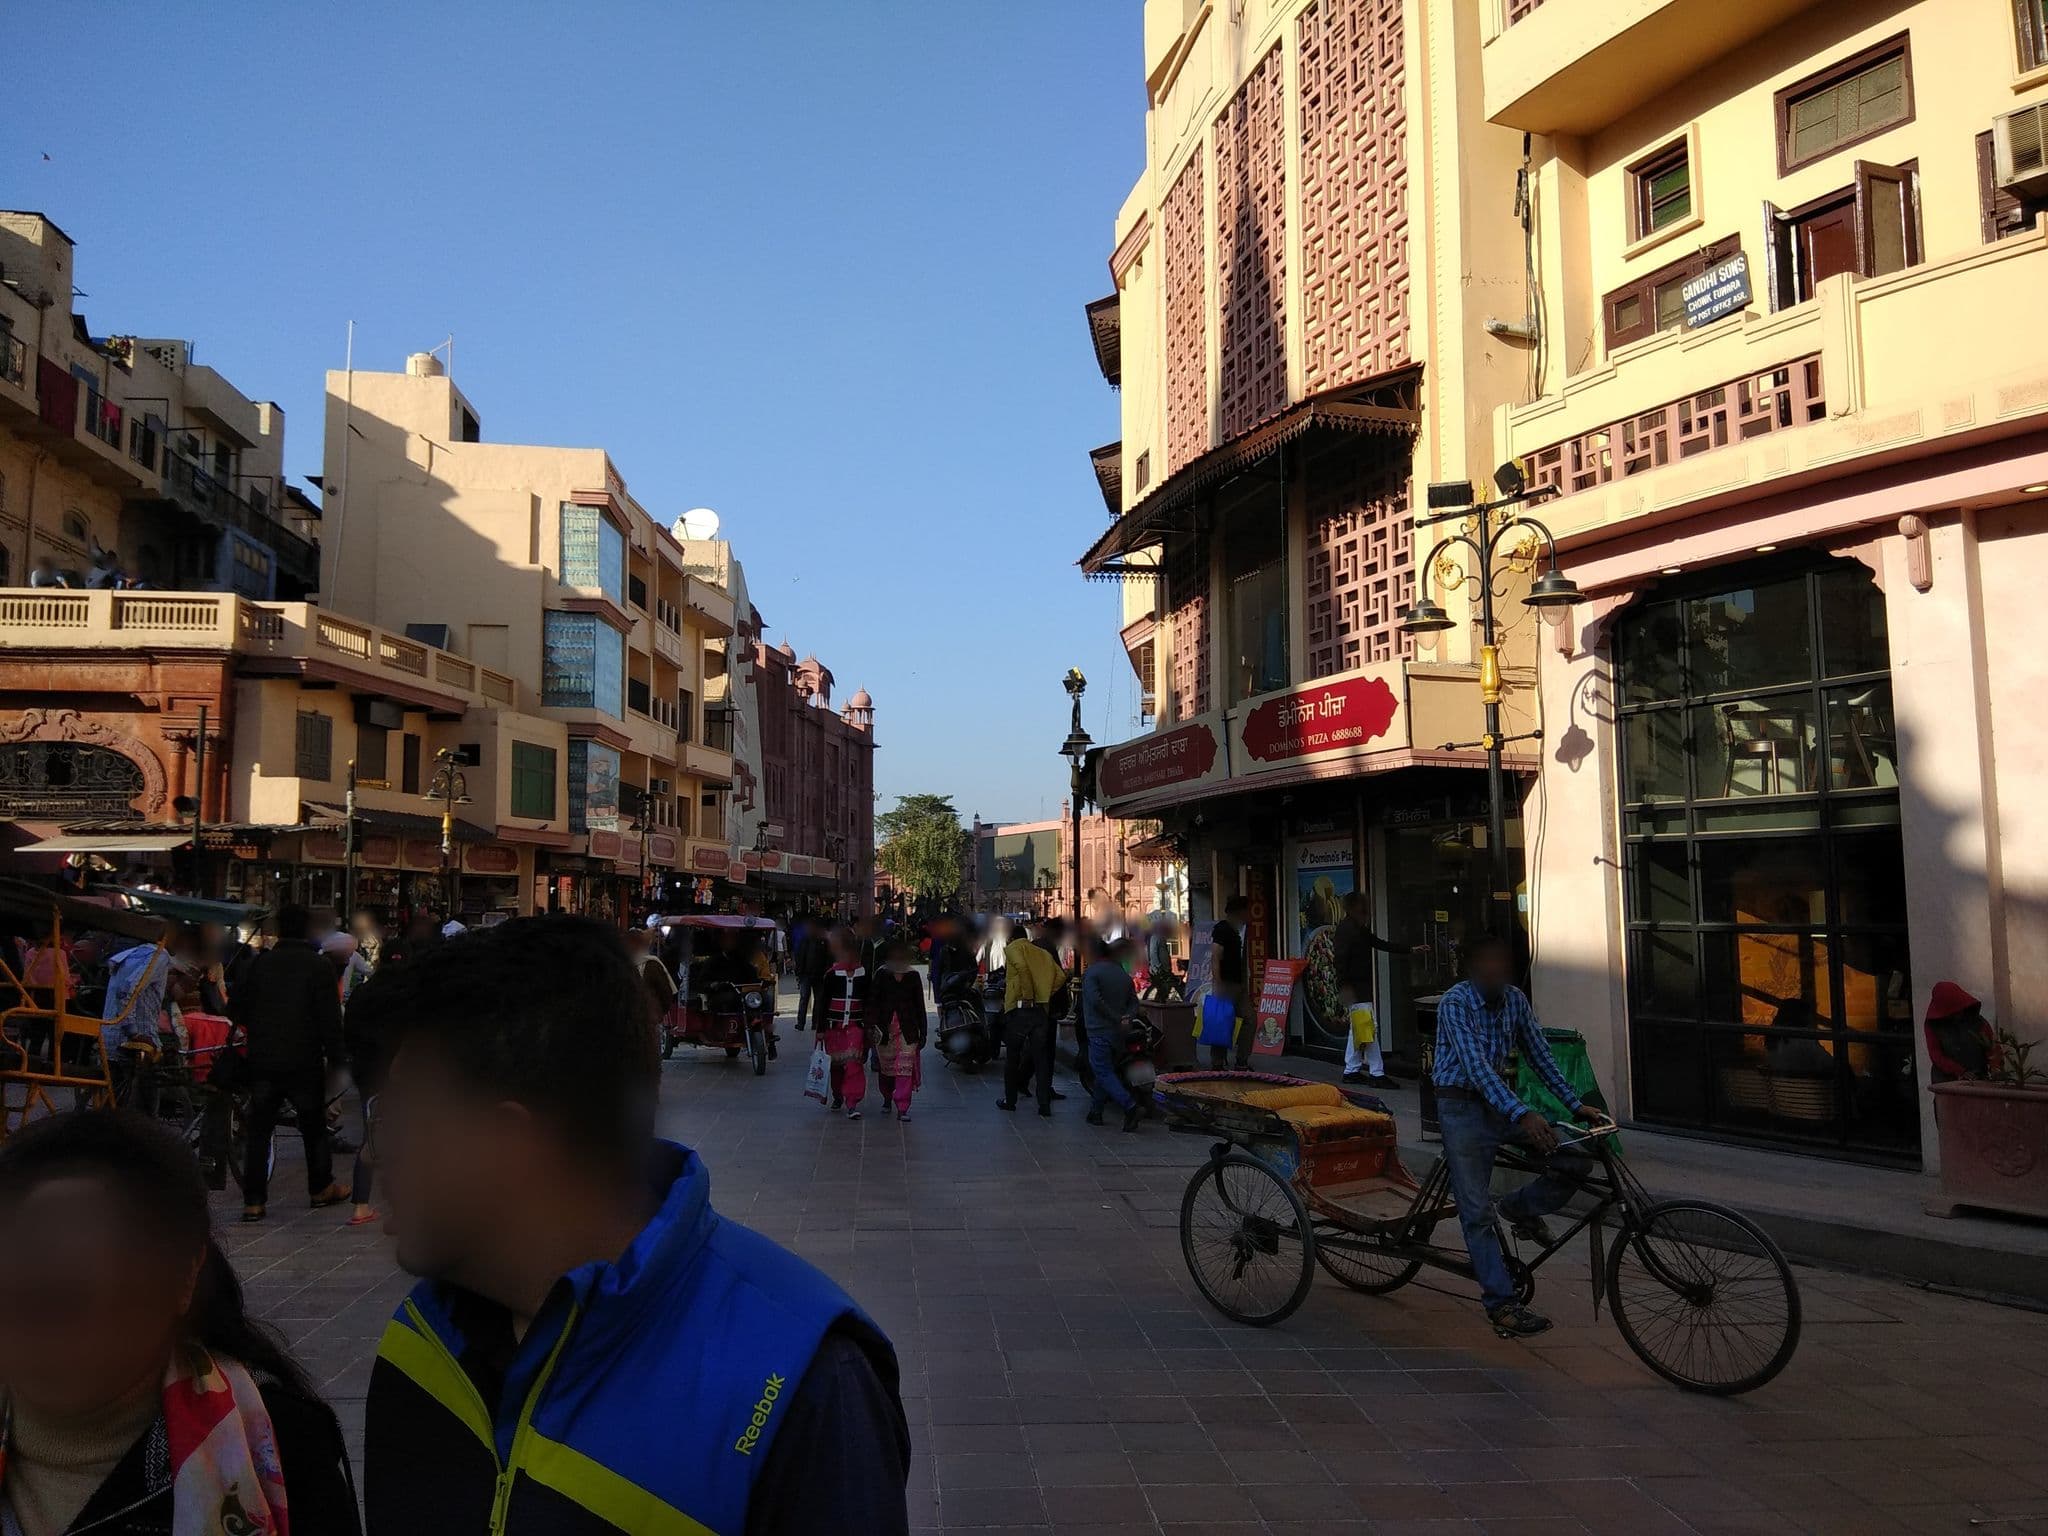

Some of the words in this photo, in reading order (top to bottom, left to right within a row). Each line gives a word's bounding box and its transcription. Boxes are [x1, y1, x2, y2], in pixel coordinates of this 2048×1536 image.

[1682, 271, 1718, 301] GANDHI
[1719, 256, 1746, 283] SONS
[1688, 293, 1712, 312] CHOWK
[1713, 279, 1741, 299] FUWARA
[1697, 307, 1712, 321] POST
[1712, 298, 1732, 313] OFFICE
[1269, 736, 1305, 755] DOMINO'S
[1307, 731, 1329, 747] PIZZA
[1331, 726, 1363, 742] 6888688
[1342, 849, 1352, 862] Piz
[1195, 931, 1214, 944] BRO
[1259, 998, 1287, 1014] DHABA
[734, 1371, 786, 1456] Reebok
